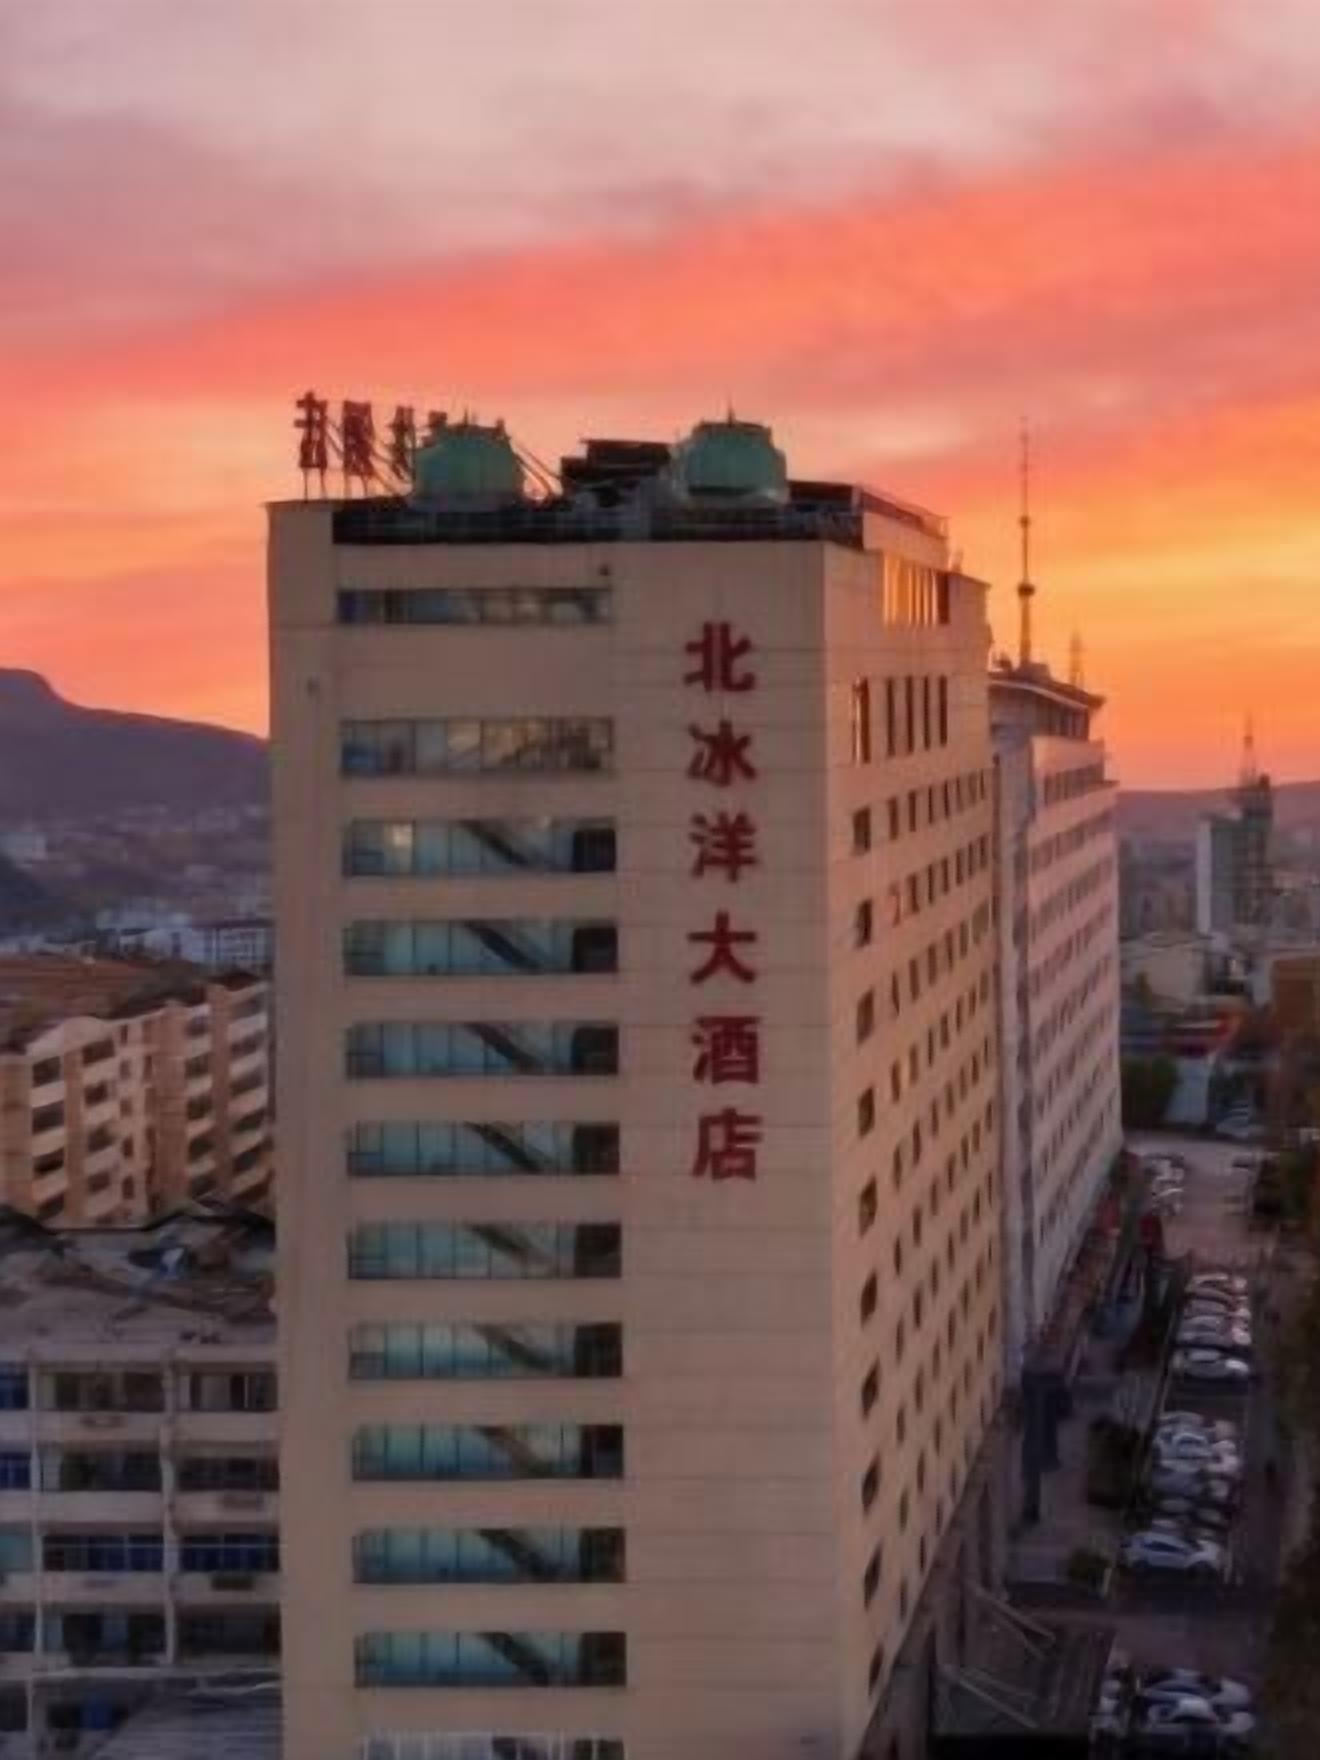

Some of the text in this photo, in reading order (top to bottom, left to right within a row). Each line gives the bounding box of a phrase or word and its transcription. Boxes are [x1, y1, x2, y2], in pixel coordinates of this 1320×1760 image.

[683, 621, 763, 1182] 北冰洋大酒店
